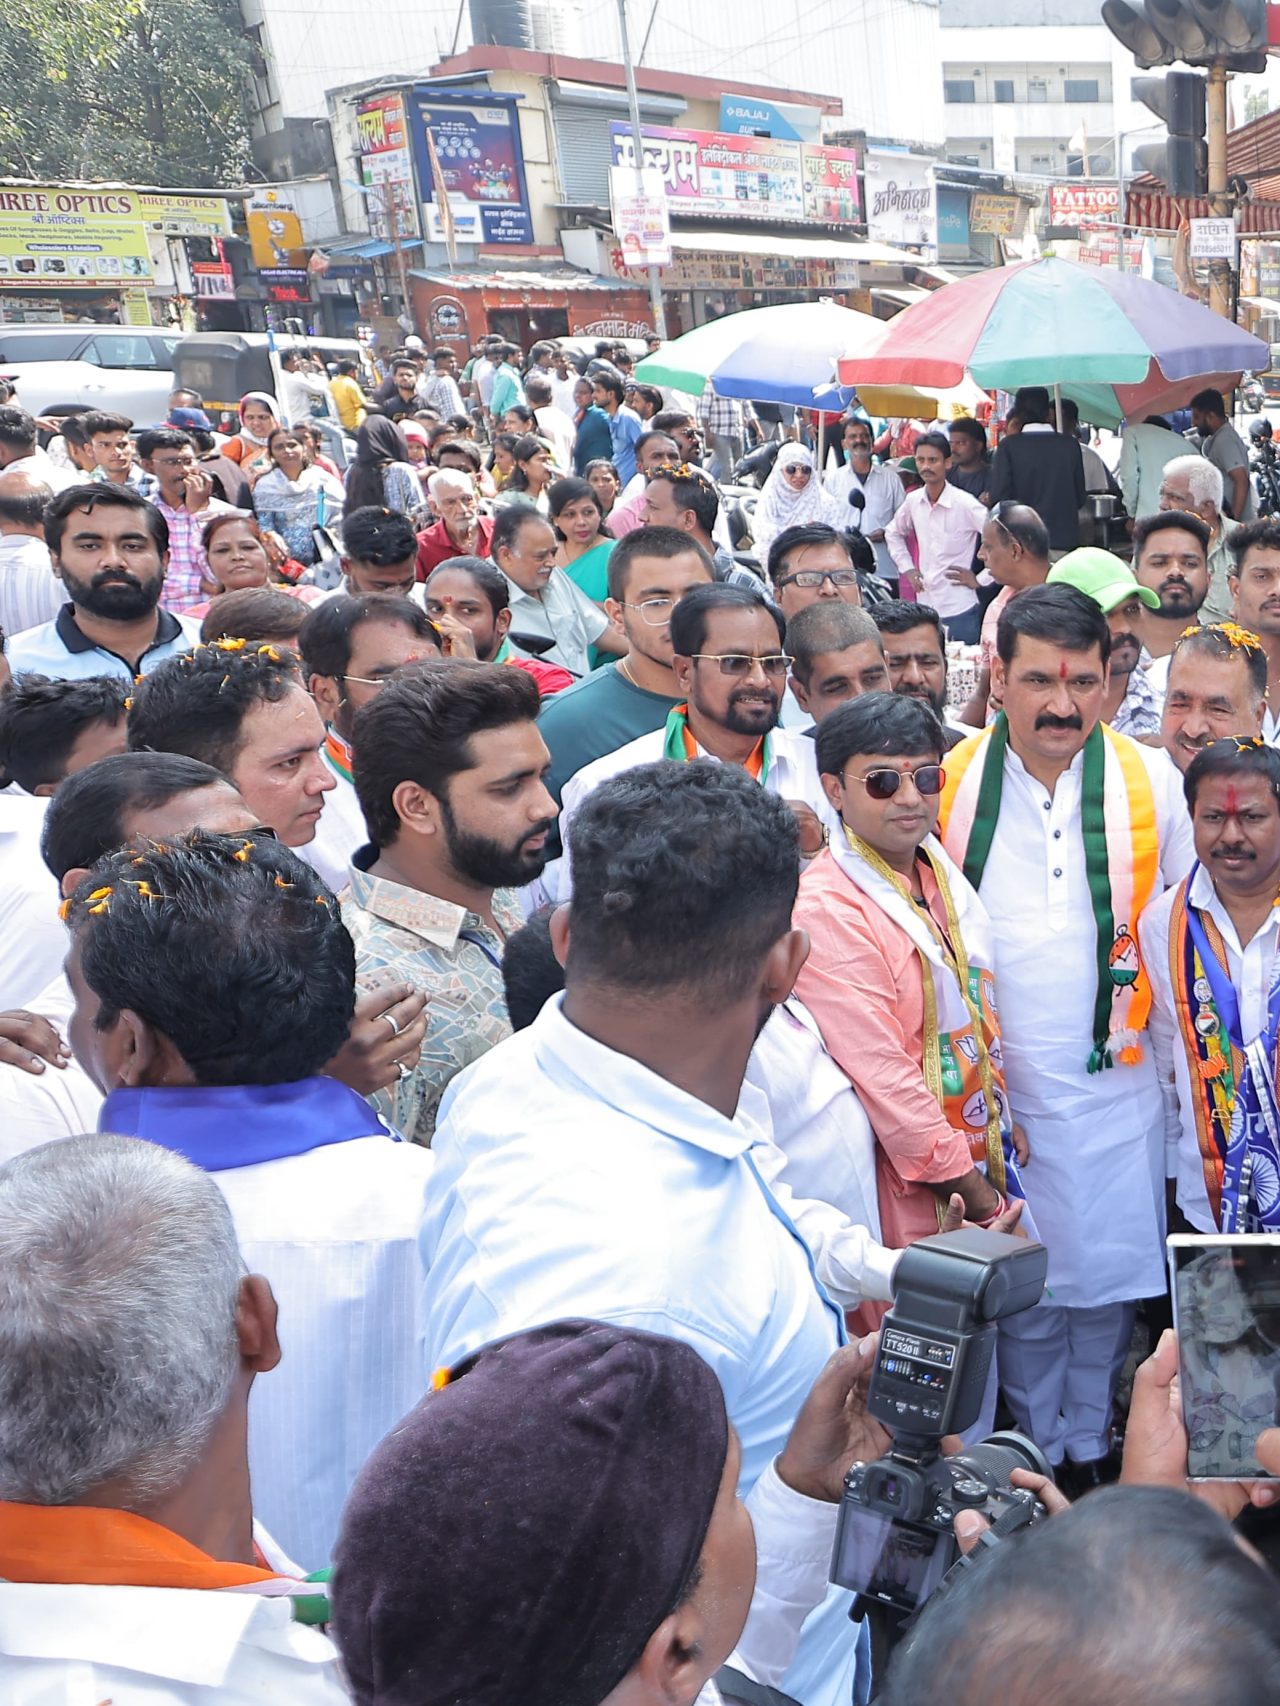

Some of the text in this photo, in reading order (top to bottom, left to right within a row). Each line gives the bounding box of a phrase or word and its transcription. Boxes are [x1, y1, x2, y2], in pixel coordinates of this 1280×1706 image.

[735, 107, 770, 121] BAJAJ
[56, 194, 132, 214] OPTICS
[1053, 191, 1119, 206] TATTOO
[886, 1338, 913, 1354] TT520
